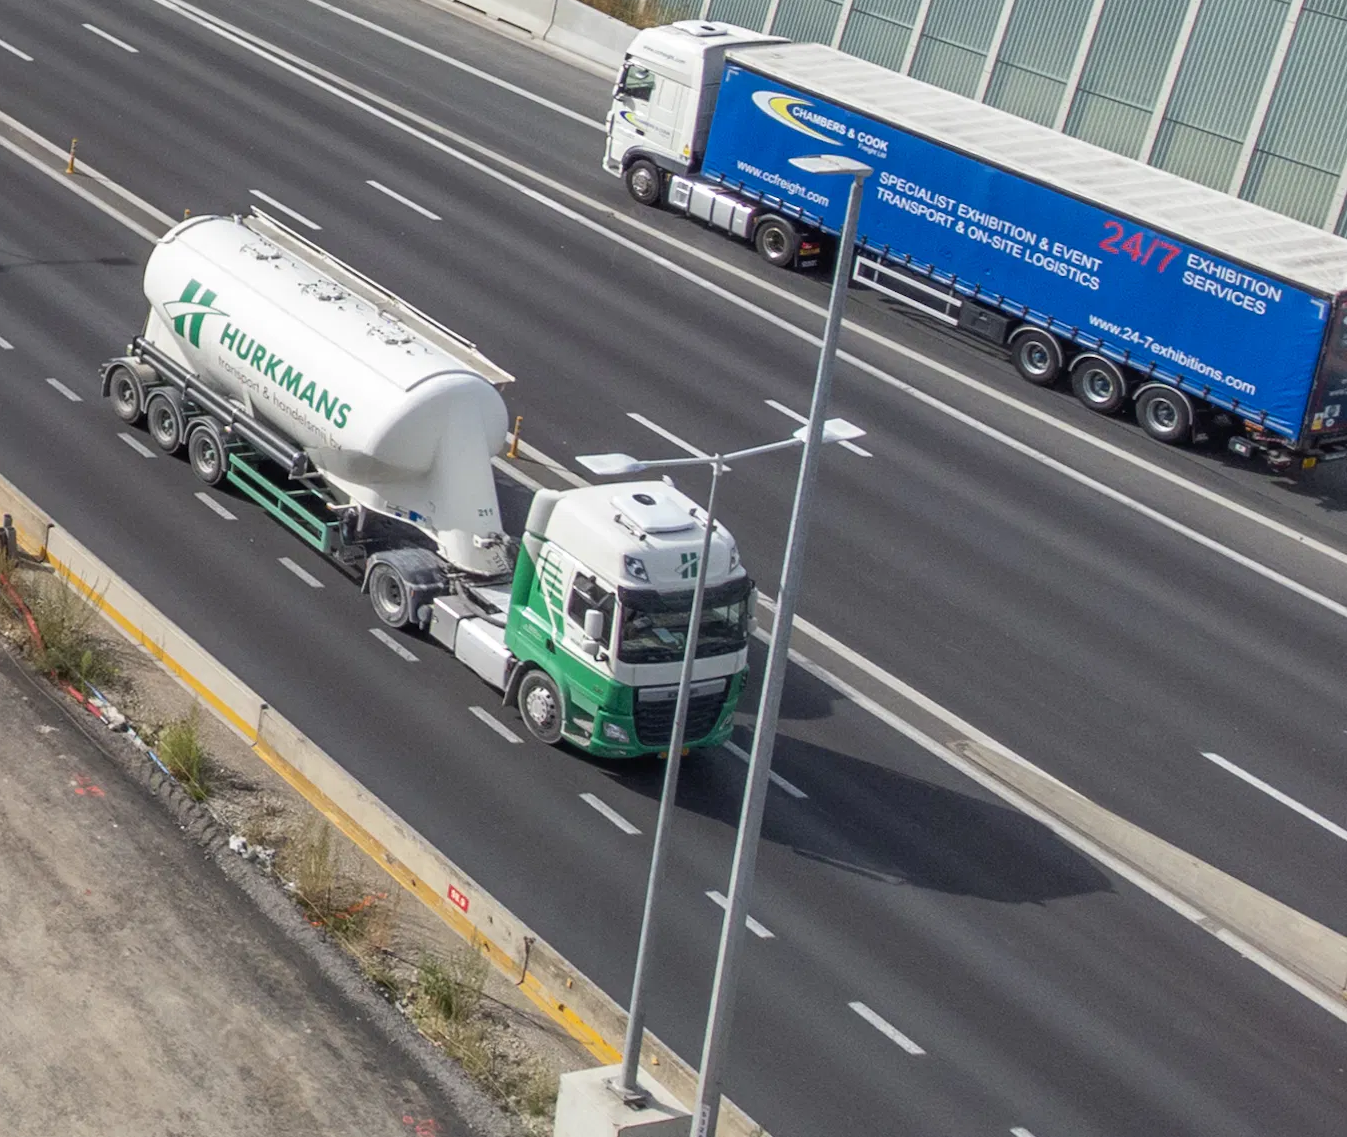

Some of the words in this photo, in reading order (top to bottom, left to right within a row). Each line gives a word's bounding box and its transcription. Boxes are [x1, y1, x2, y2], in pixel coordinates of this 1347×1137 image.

[792, 106, 846, 136] CHAMBERS
[847, 128, 856, 139] &
[857, 132, 889, 152] COOK
[737, 160, 829, 207] www.ccfreight.com
[877, 187, 955, 228] TRANSPORT
[955, 221, 965, 235] &
[967, 226, 1022, 258] ON-SITE
[1025, 251, 1100, 291] LOGISTICS
[879, 171, 956, 211] SPECIALIST
[958, 203, 1037, 245] EXHIBITION
[1039, 237, 1049, 251] &
[1052, 242, 1102, 272] EVENT
[1098, 220, 1182, 273] 24/7
[1182, 271, 1267, 315] SERVICES
[1186, 253, 1282, 302] EXHIBITION
[218, 356, 260, 394] transport
[263, 386, 271, 400] &
[219, 322, 352, 429] HURKMANS
[1089, 315, 1256, 395] www.24-7exhibitions.com
[477, 508, 494, 517] 211
